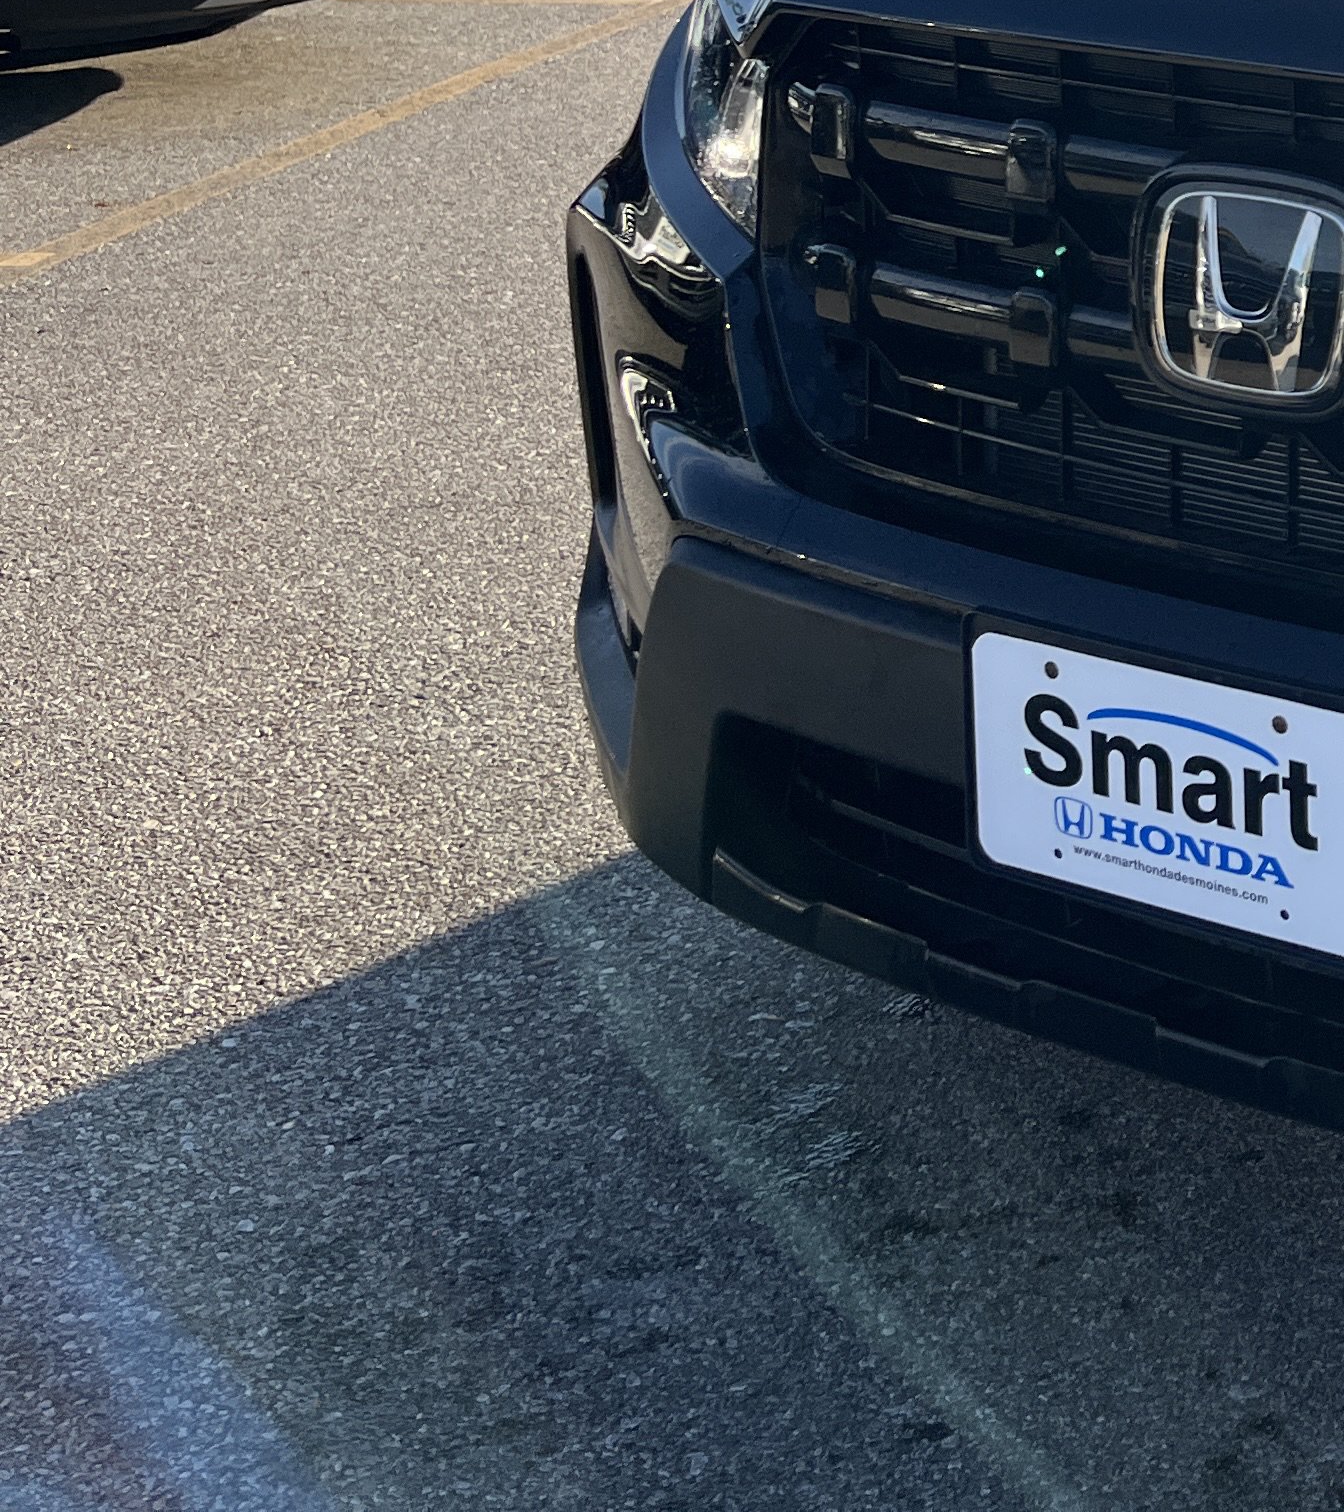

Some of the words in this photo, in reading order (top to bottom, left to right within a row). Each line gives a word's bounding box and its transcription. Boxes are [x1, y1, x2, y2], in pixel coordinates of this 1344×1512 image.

[1023, 694, 1319, 851] Smart
[1073, 845, 1269, 905] www.smarthondadesmoines.com
[1100, 813, 1295, 888] HONDA
